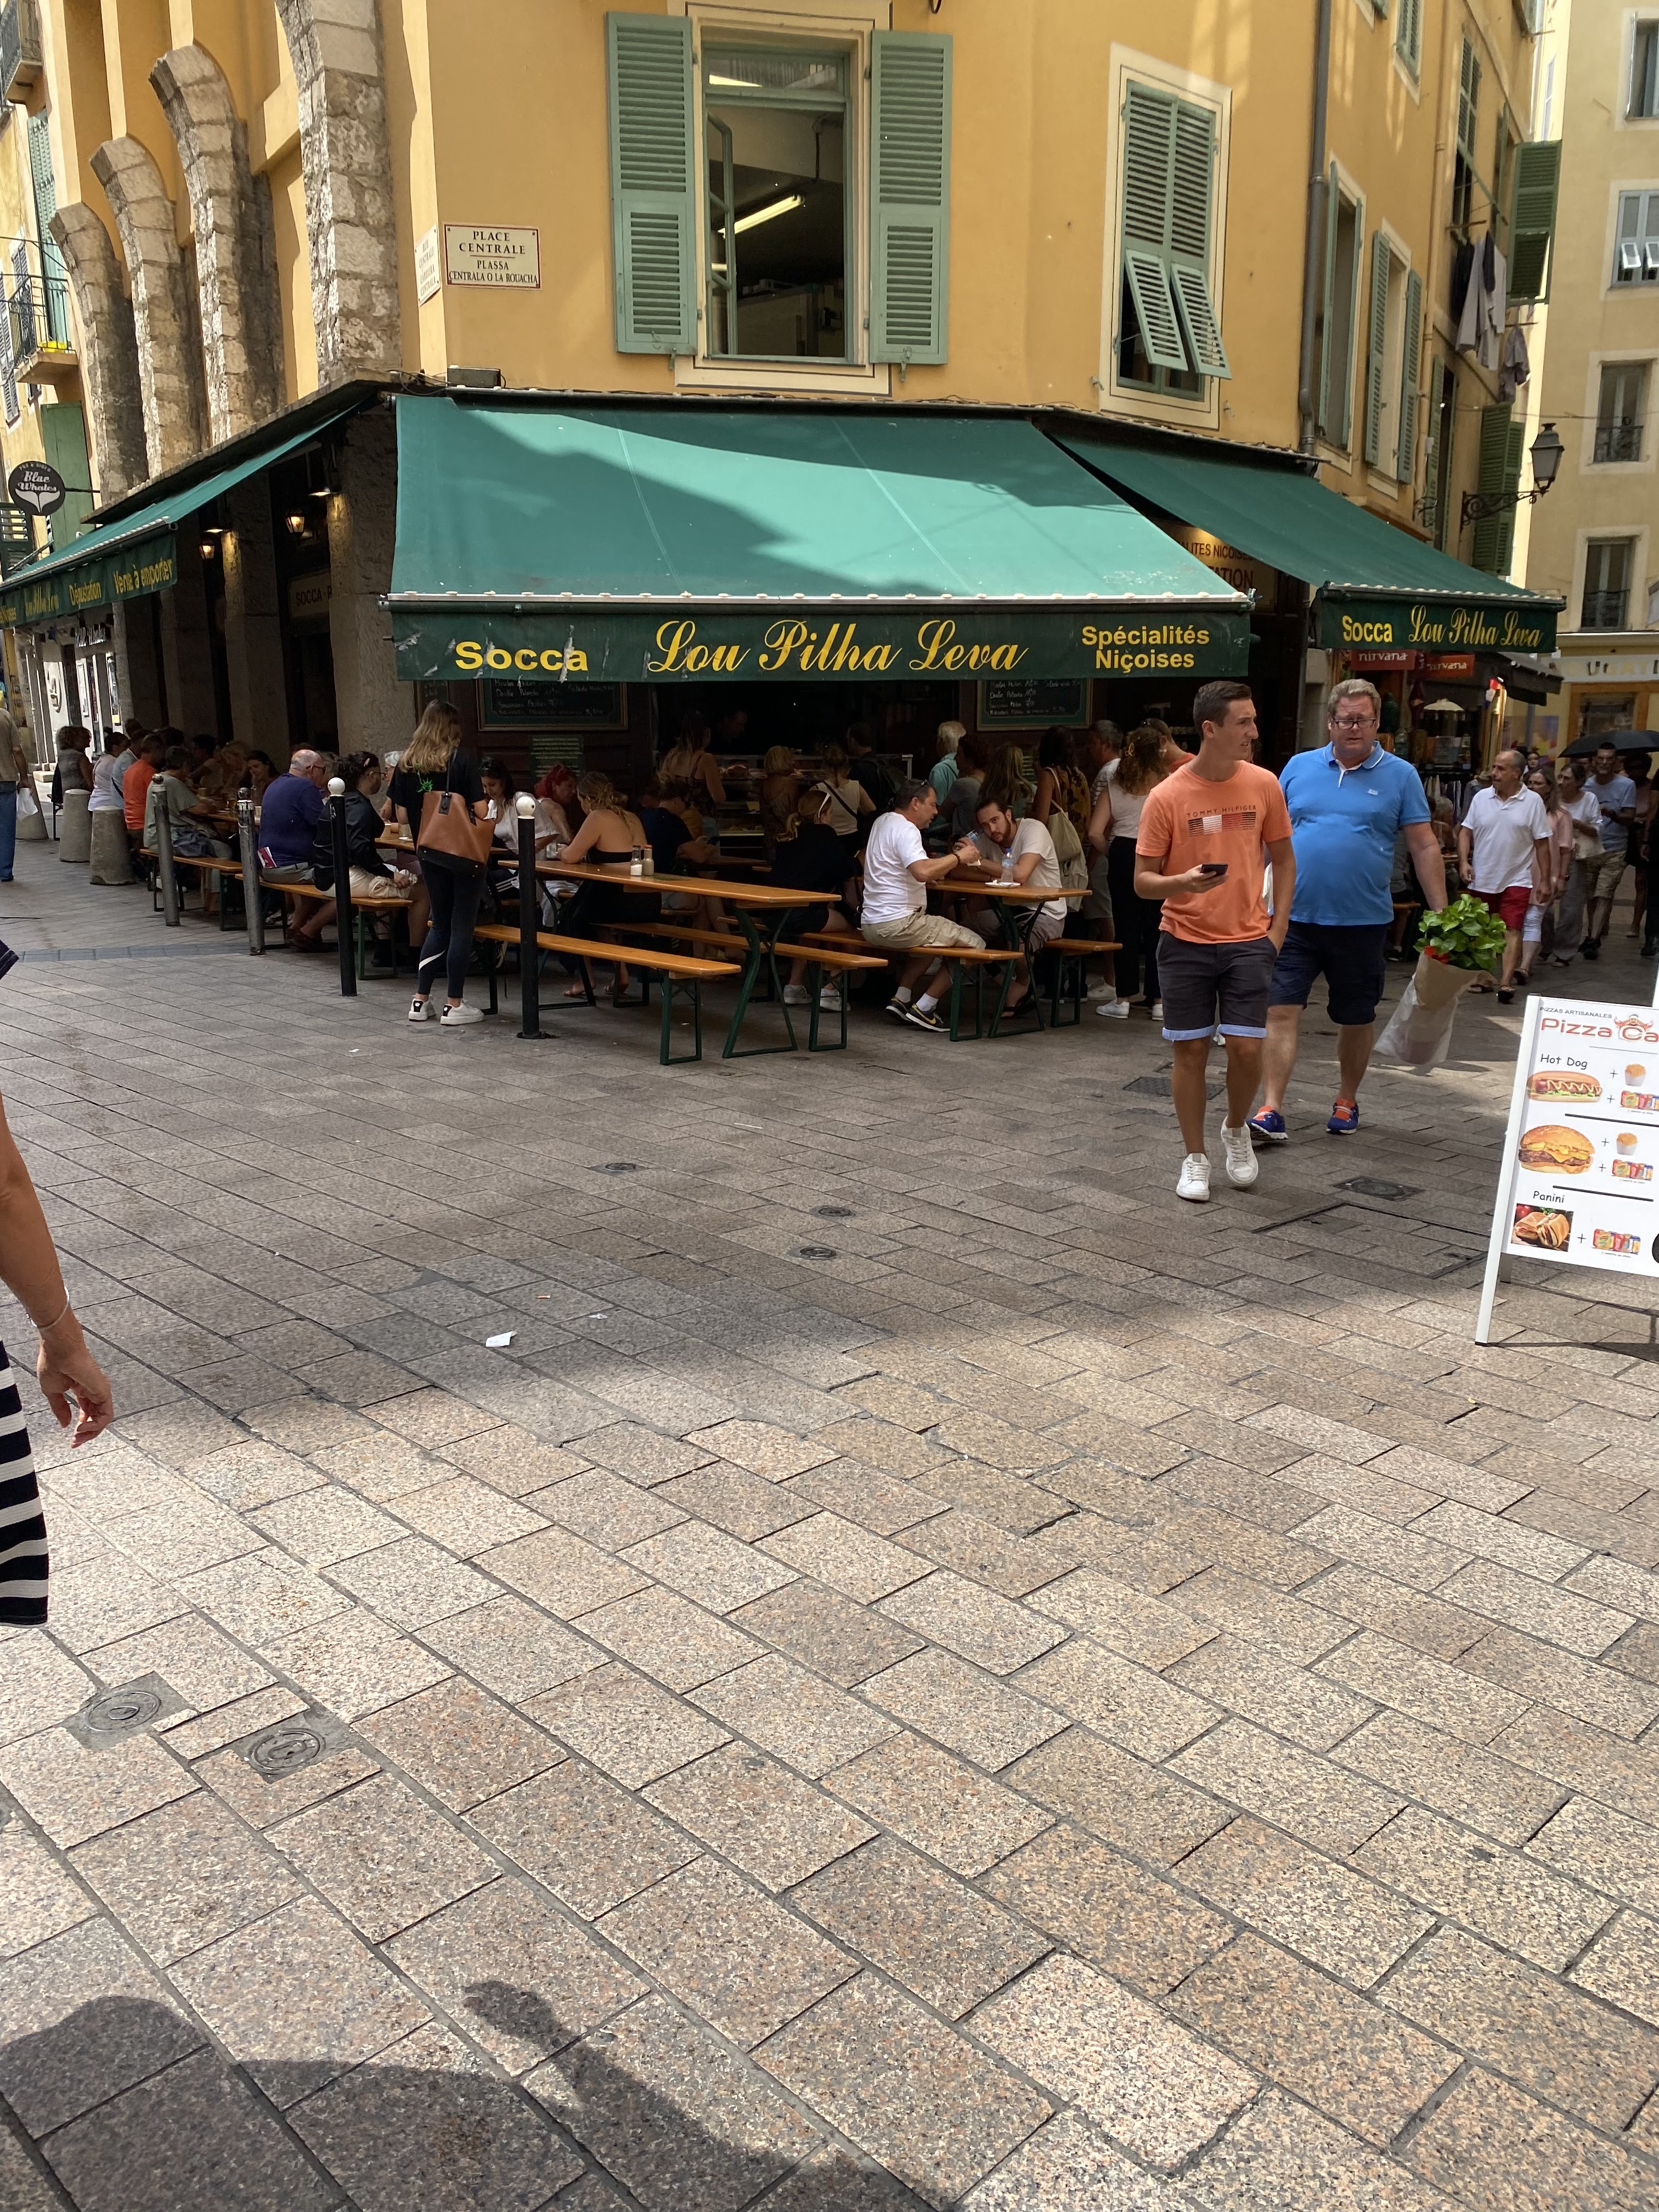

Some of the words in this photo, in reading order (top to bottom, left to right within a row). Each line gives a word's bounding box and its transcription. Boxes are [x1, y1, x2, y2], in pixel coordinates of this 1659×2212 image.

[473, 231, 510, 241] PLACE
[459, 243, 526, 255] CENTRALE
[477, 260, 509, 270] PLASSA
[449, 270, 486, 281] CENTRALA
[487, 273, 493, 281] O
[495, 273, 504, 282] LA
[506, 273, 538, 284] ROUACHA
[24, 471, 51, 483] Blue
[18, 482, 57, 492] Whales
[296, 588, 323, 606] SOCCA
[1342, 615, 1393, 642] Socca
[1408, 605, 1447, 644] Lou
[1448, 607, 1499, 646] Pilha
[1500, 611, 1544, 647] Leva
[1082, 625, 1210, 650] Spécialités
[647, 620, 751, 672] Lou
[759, 620, 902, 672] Pilha
[909, 619, 1029, 671] Leva
[455, 641, 589, 672] Socca
[1096, 649, 1194, 673] Niçoises
[1358, 651, 1408, 662] nirvana
[1187, 809, 1217, 818] TOMMY
[1222, 805, 1256, 813] HILFIGER
[1565, 1009, 1612, 1019] ARTISANALES
[1541, 1018, 1613, 1038] Pizza
[1540, 1053, 1561, 1065] Hot
[1567, 1057, 1588, 1070] Dog
[1533, 1190, 1565, 1204] Panini
